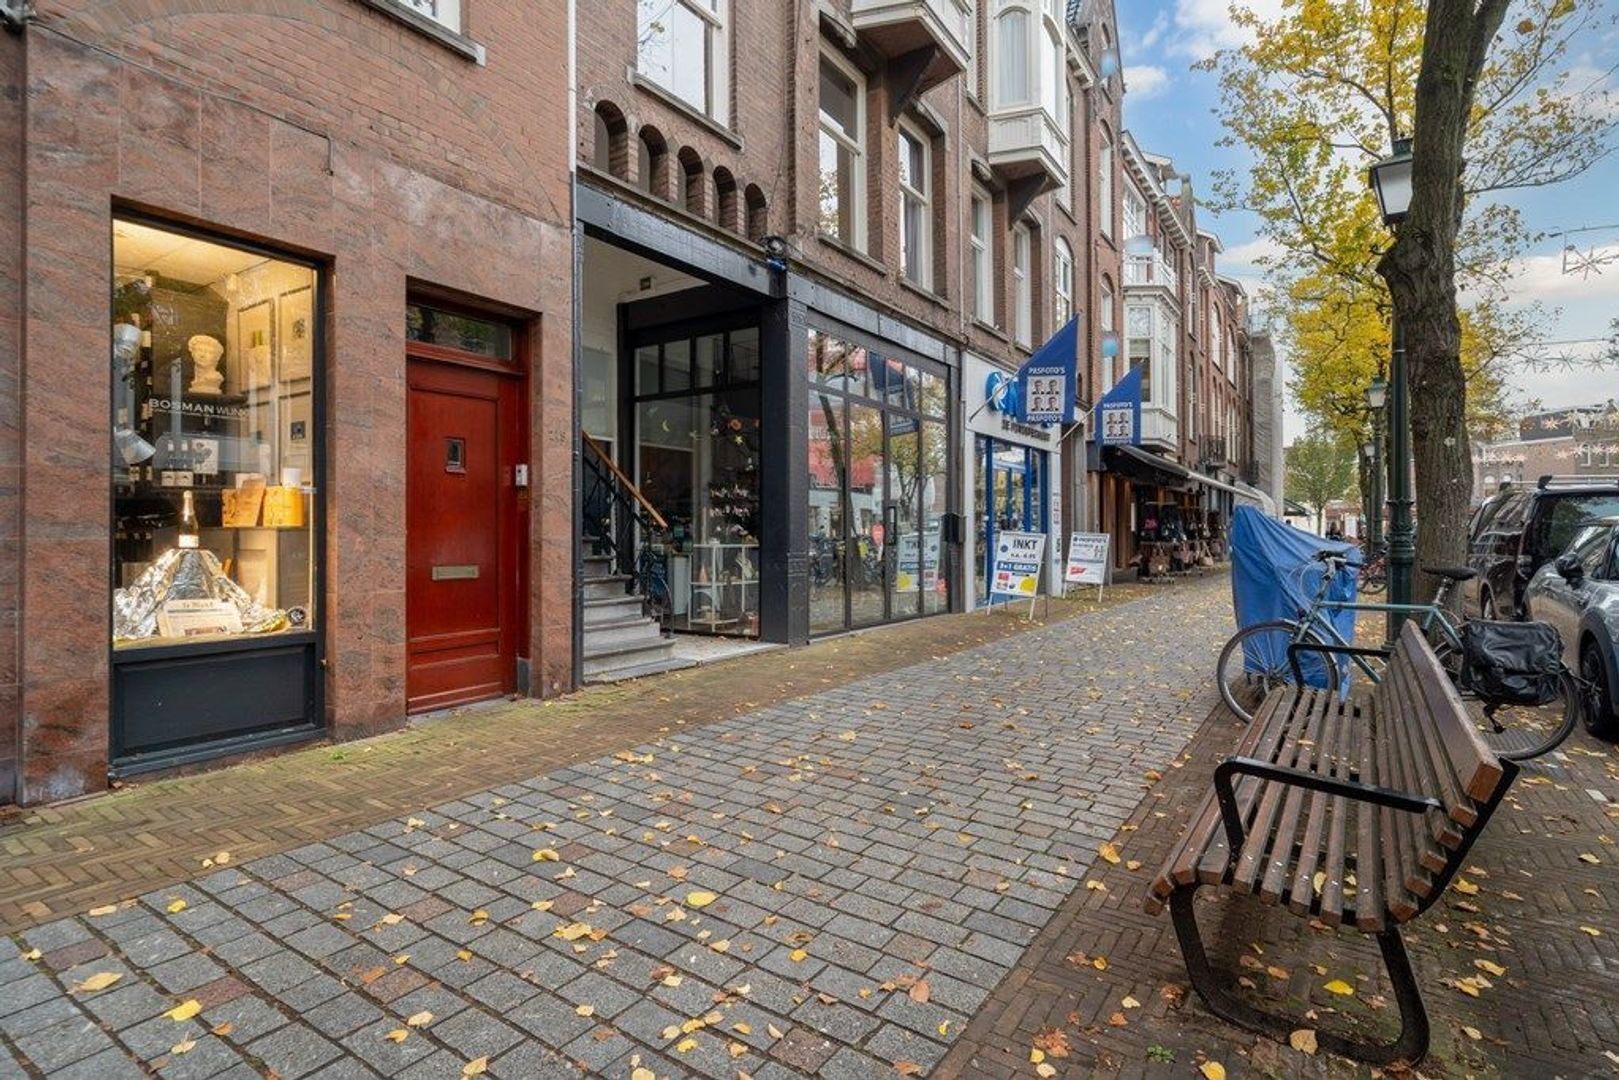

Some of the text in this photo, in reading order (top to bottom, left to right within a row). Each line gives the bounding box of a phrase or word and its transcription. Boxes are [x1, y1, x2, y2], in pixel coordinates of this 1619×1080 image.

[1028, 366, 1066, 375] PASFOTO'S
[148, 398, 214, 413] BOSMAN
[1012, 540, 1038, 550] INKT
